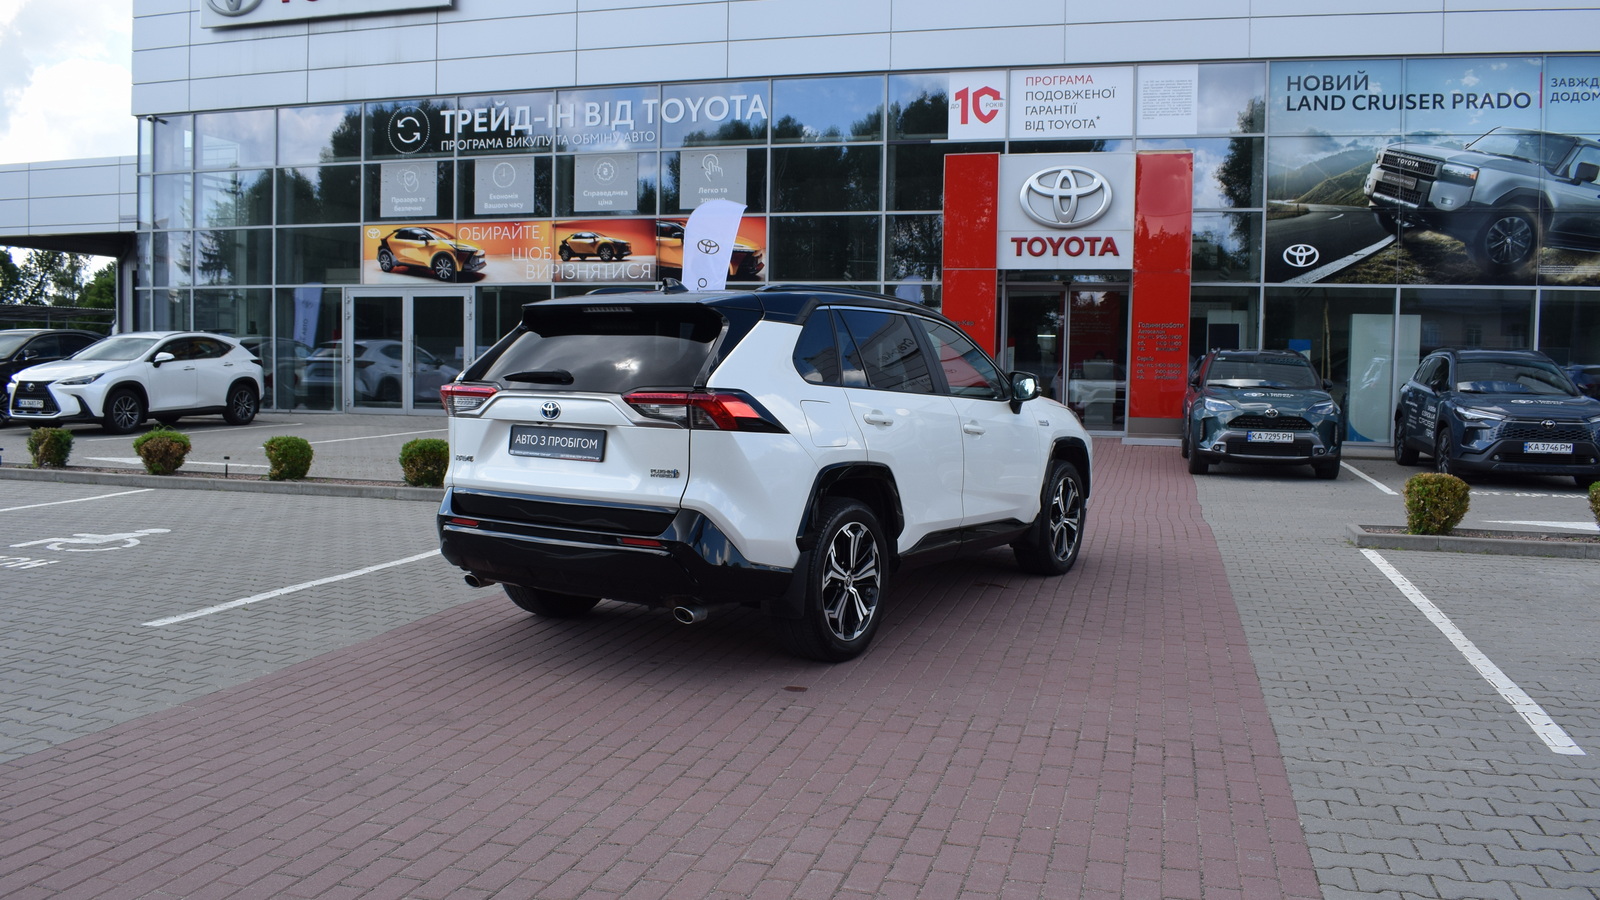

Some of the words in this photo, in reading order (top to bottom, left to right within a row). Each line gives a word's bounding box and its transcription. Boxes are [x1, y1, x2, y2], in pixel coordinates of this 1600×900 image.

[1026, 75, 1094, 86] ПРОГРАМА
[1287, 71, 1369, 92] НОВИЙ
[1550, 77, 1600, 89] ЗАВЖД
[1025, 86, 1117, 102] ПОДОВЖЕНОЇ
[1286, 95, 1346, 111] LAND
[1352, 94, 1446, 110] CRUISER
[1452, 92, 1532, 109] PRADO
[440, 101, 575, 136] ТРЕЙД-ІН
[585, 100, 635, 131] ВІД
[642, 93, 768, 124] TOYOTA
[1025, 103, 1078, 116] ГАРАНТІЇ
[1025, 120, 1045, 132] ВІД
[441, 137, 504, 151] ПРОГРАМА
[506, 134, 553, 149] ВИКУПУ
[556, 133, 570, 146] ТА
[572, 131, 621, 146] ОБМІНУ
[624, 130, 656, 143] АВТО
[1397, 158, 1419, 167] TOYOTA
[458, 222, 546, 242] ОБИРАЙТЕ,
[511, 246, 552, 262] ЩОБ
[1011, 237, 1120, 257] TOYOTA
[525, 261, 652, 280] ВИРІЗНЯТИСЯ
[515, 434, 538, 445] АВТО
[540, 435, 546, 446] З
[547, 436, 598, 449] ПРОБІГОМ
[1252, 432, 1263, 440] KA
[1265, 432, 1281, 440] 7295
[1528, 443, 1540, 451] KA
[1541, 444, 1559, 452] 3746
[1560, 444, 1572, 452] PM
